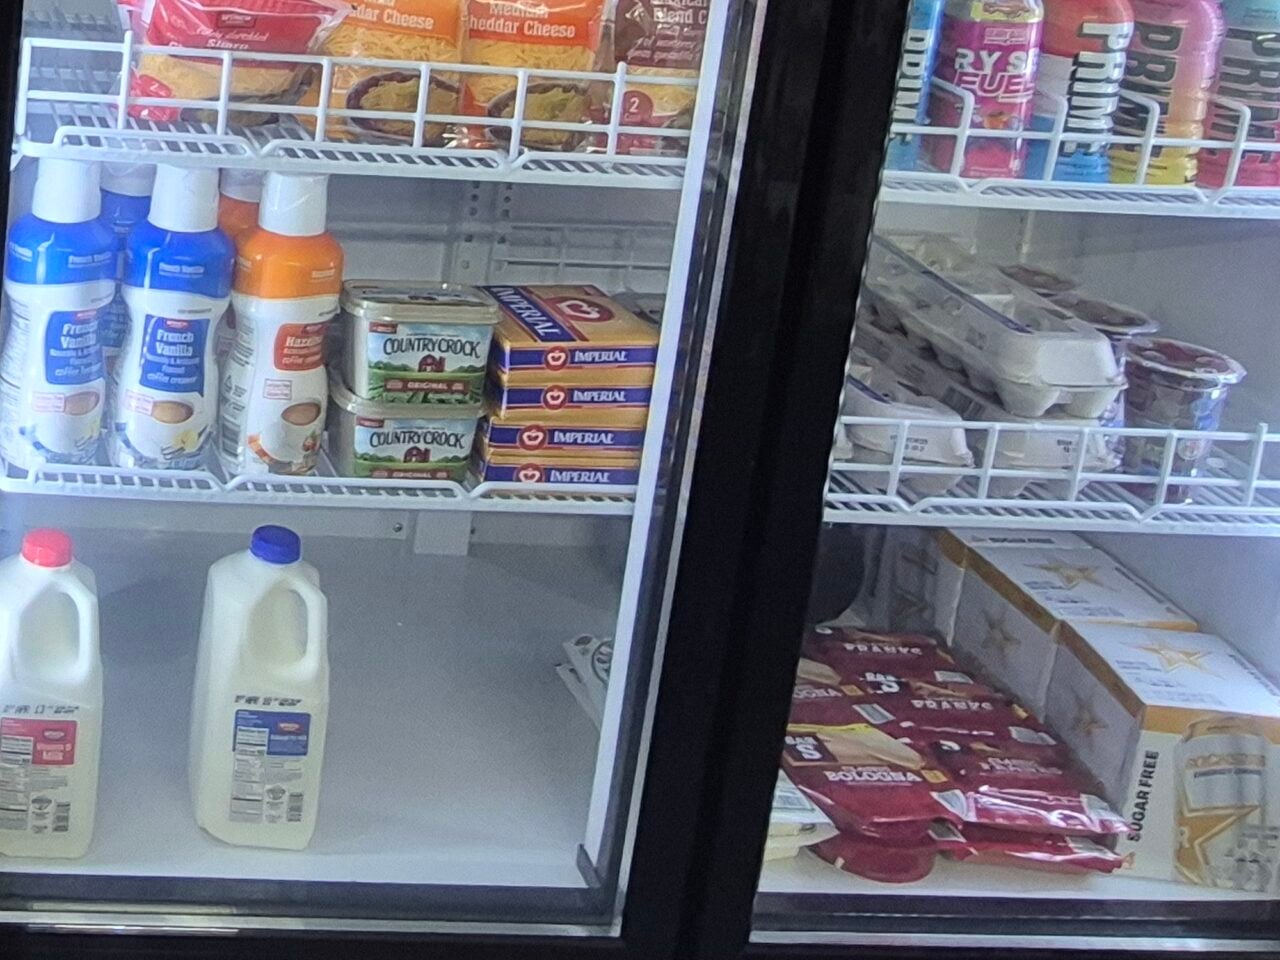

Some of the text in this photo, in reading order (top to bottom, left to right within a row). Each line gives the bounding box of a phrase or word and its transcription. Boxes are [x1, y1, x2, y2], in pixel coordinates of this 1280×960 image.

[382, 7, 435, 30] Cheese
[523, 21, 576, 38] Cheese
[156, 329, 195, 343] French
[155, 341, 194, 358] Vanilla
[383, 337, 481, 359] COUNTRY CROCK
[574, 350, 628, 363] IMPERIAL
[572, 389, 626, 402] IMPERIAL
[369, 430, 466, 450] COUNTRY CROCK
[553, 430, 614, 445] IMPERIAL
[549, 469, 610, 483] IMPERIAL
[824, 770, 924, 783] BOLOGNA
[1127, 750, 1160, 842] SUGAR FREE
